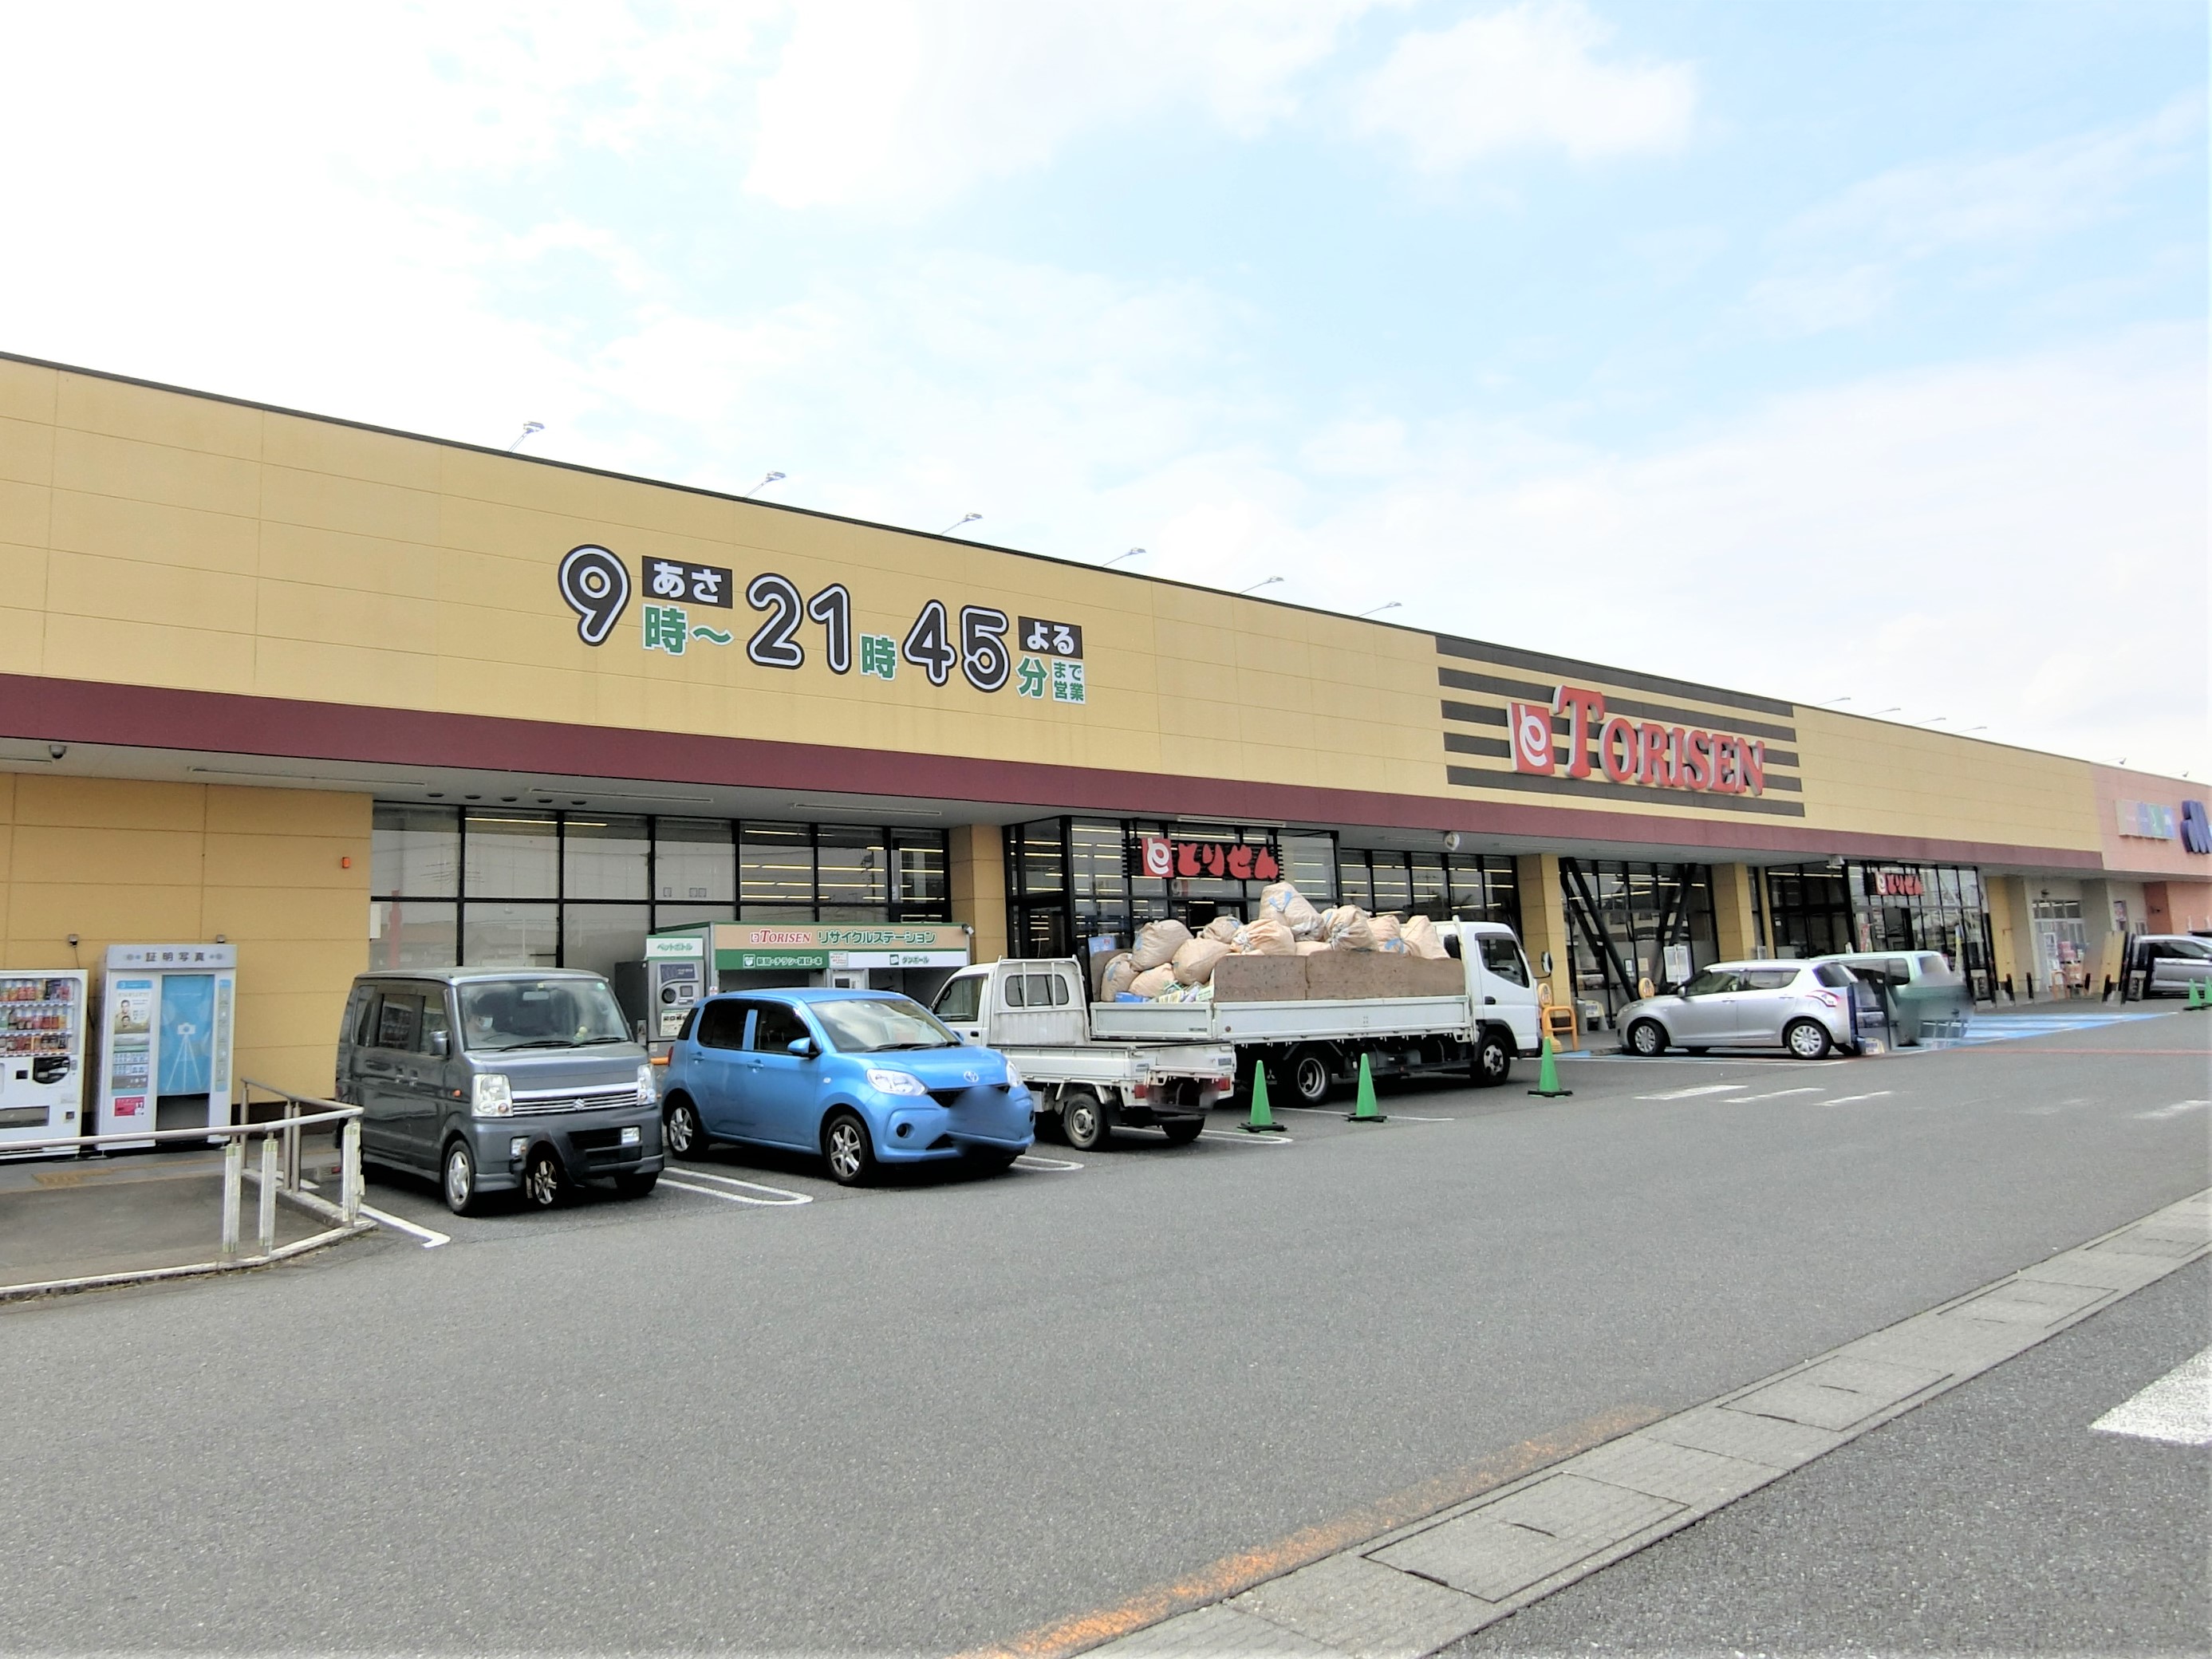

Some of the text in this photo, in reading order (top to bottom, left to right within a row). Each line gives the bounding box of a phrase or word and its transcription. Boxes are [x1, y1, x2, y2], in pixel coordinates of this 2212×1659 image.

[558, 543, 632, 647] 9
[653, 562, 724, 604] あさ
[746, 572, 853, 676] 21
[901, 599, 1011, 693] 45
[1025, 621, 1075, 656] よる
[1016, 656, 1048, 699] 分
[1053, 660, 1083, 680] まで
[1053, 680, 1084, 702] 営業
[1552, 684, 1765, 796] TORISEN
[1177, 842, 1279, 880] とりせん
[759, 929, 936, 944] TORISEN リサイクルステーション
[145, 952, 205, 963] 証明写真
